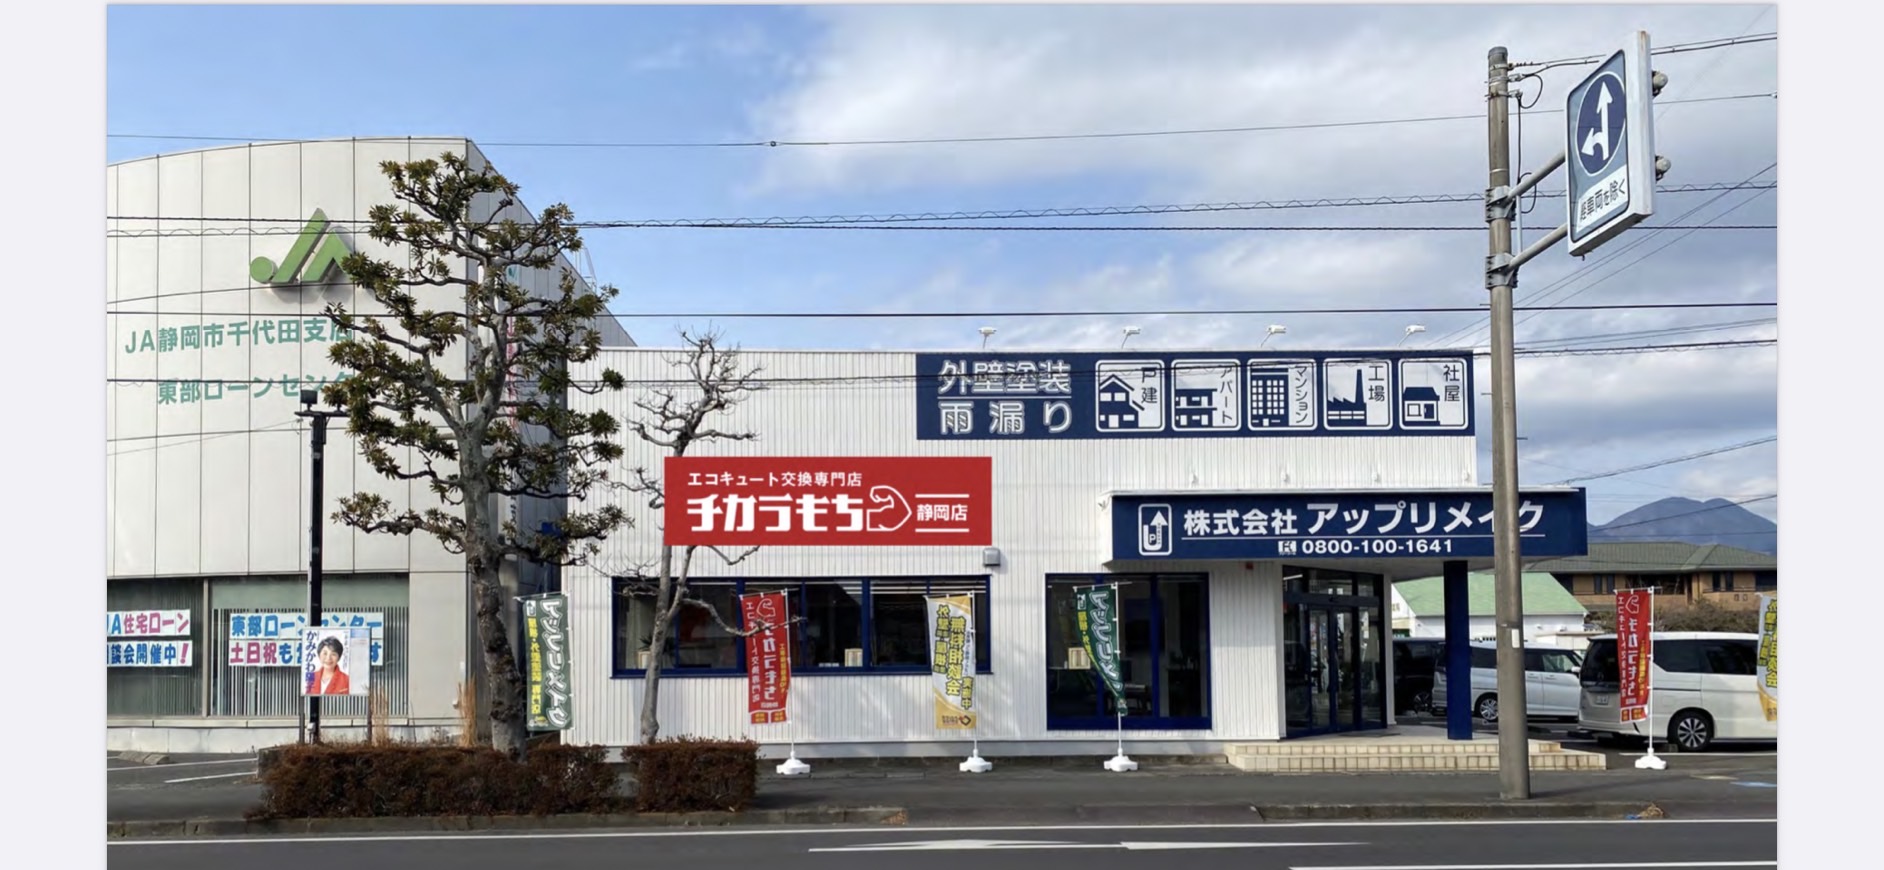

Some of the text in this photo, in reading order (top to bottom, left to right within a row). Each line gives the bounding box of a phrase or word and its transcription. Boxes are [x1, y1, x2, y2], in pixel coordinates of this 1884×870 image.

[937, 359, 1072, 394] 外壁塗装
[1141, 366, 1158, 404] 戸建
[1367, 365, 1386, 402] 工場
[1442, 364, 1461, 403] 社屋
[1219, 365, 1233, 425] アパート
[1295, 365, 1309, 424] マンション
[937, 400, 1073, 434] 雨漏り
[687, 471, 863, 488] エコキュート交換専門店
[686, 493, 864, 532] チカラもち
[916, 503, 968, 522] 静岡店
[1183, 508, 1298, 535] 株式会社
[1302, 540, 1452, 554] 0800-100-1641
[107, 612, 190, 635] A住宅ローン
[107, 642, 190, 665] 談会開催中!
